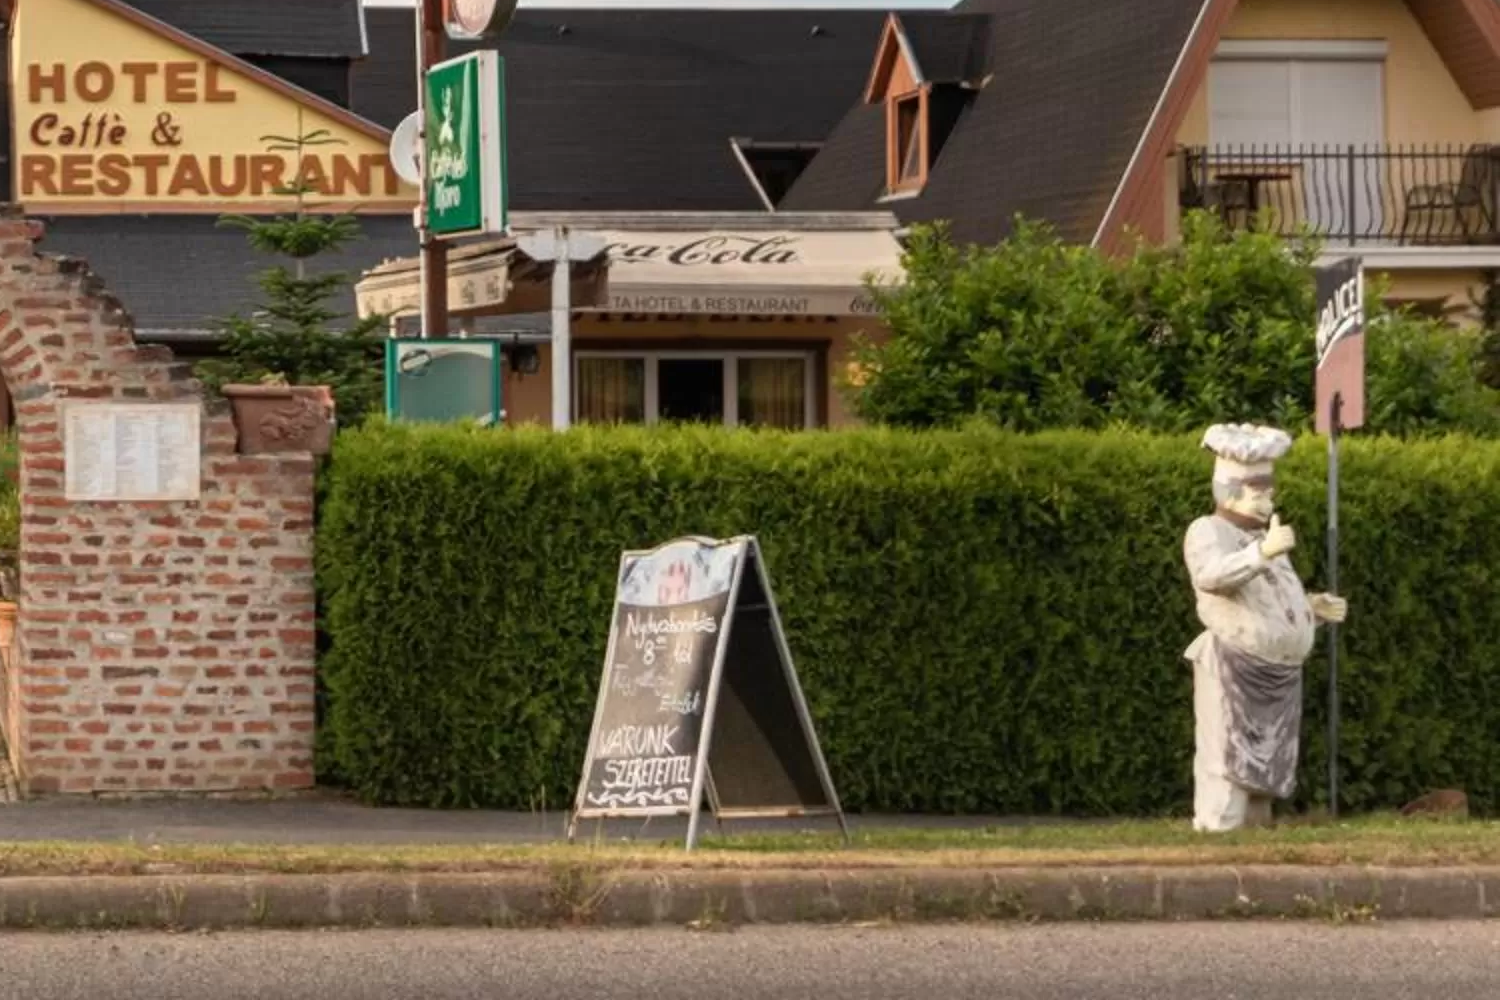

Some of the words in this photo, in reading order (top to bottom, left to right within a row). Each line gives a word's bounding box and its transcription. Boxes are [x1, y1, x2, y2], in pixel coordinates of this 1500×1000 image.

[28, 60, 237, 104] HOTEL
[29, 111, 127, 147] Caffè
[151, 111, 182, 147] &
[21, 153, 399, 197] RESTAURANT
[603, 234, 801, 266] ca-Cola
[612, 295, 631, 309] TA
[635, 295, 685, 310] HOTEL
[691, 295, 701, 310] &
[705, 295, 810, 312] RESTAURANT
